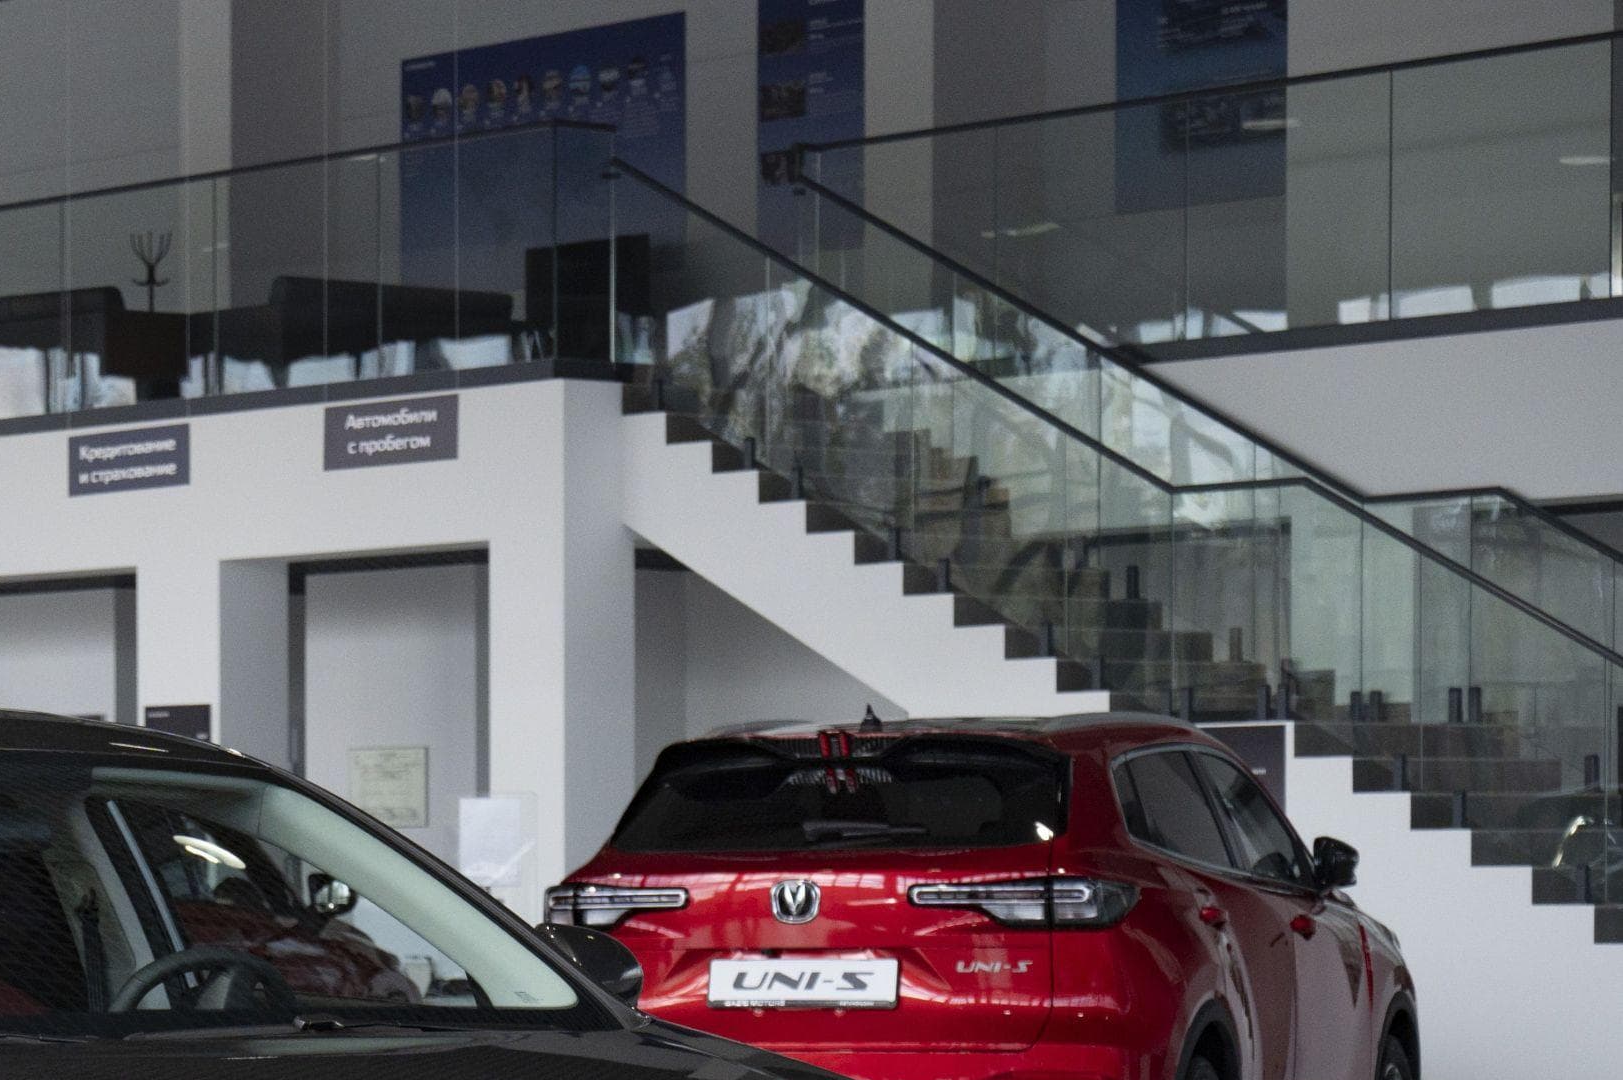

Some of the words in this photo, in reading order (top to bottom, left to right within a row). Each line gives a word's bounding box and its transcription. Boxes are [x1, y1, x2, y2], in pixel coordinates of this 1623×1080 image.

[344, 407, 438, 431] Автомобили
[79, 439, 177, 462] Кредитование
[347, 441, 358, 454] с
[358, 434, 431, 456] пробегом
[90, 463, 177, 484] страхование
[955, 959, 1033, 974] UNI-S
[733, 971, 875, 991] UNI-S
